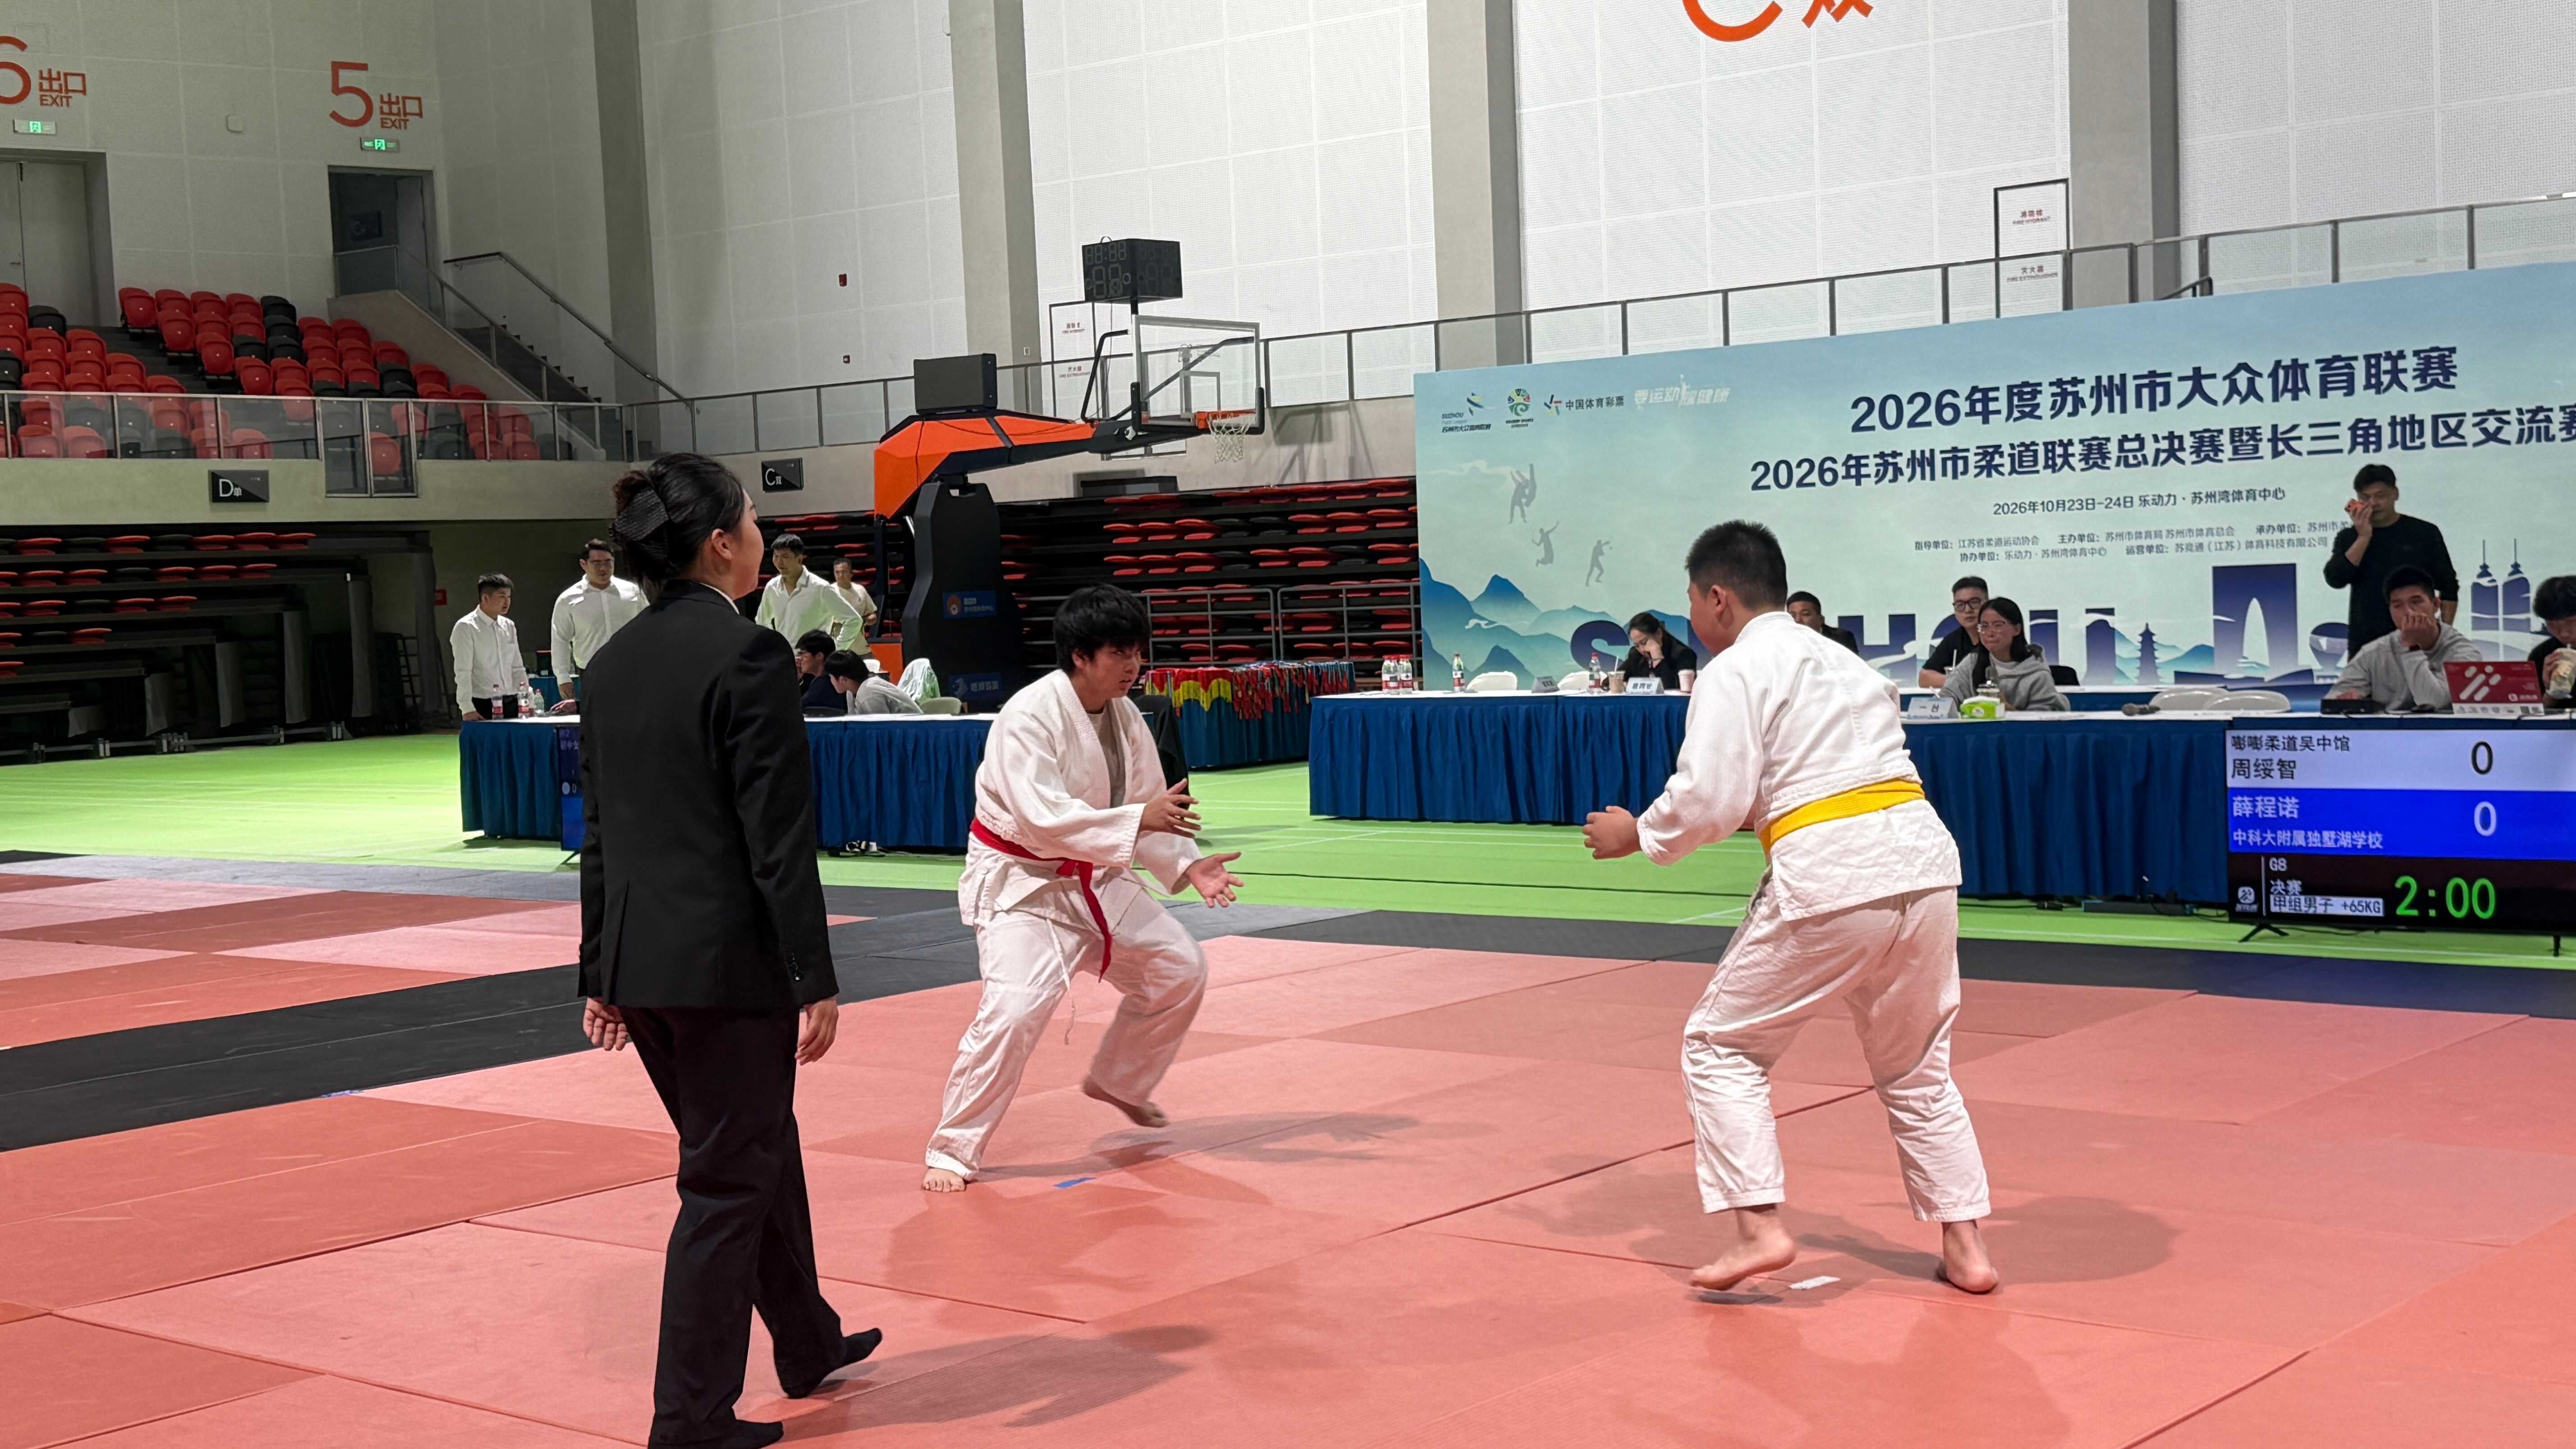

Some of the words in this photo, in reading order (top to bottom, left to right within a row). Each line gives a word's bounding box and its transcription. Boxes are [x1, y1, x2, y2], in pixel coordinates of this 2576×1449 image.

[39, 68, 87, 96] 出口
[40, 94, 72, 107] EXIT
[329, 61, 373, 127] 5
[380, 93, 423, 118] 出口
[380, 117, 409, 129] EXIT
[1851, 346, 2457, 432] 2026年度苏州市大众体育联赛
[1566, 396, 1624, 410] 中国体育彩票
[1993, 496, 2134, 515] 2026年10月23日-24日
[2471, 741, 2493, 775] 0
[2233, 795, 2300, 819] 薛程诺
[2474, 801, 2497, 837] 0
[2233, 828, 2383, 849] 中科大附属独墅湖学校
[2270, 879, 2302, 895] 决赛
[2395, 875, 2496, 920] 2:00
[2273, 895, 2333, 913] 甲组男子
[2341, 900, 2381, 914] +65KG
